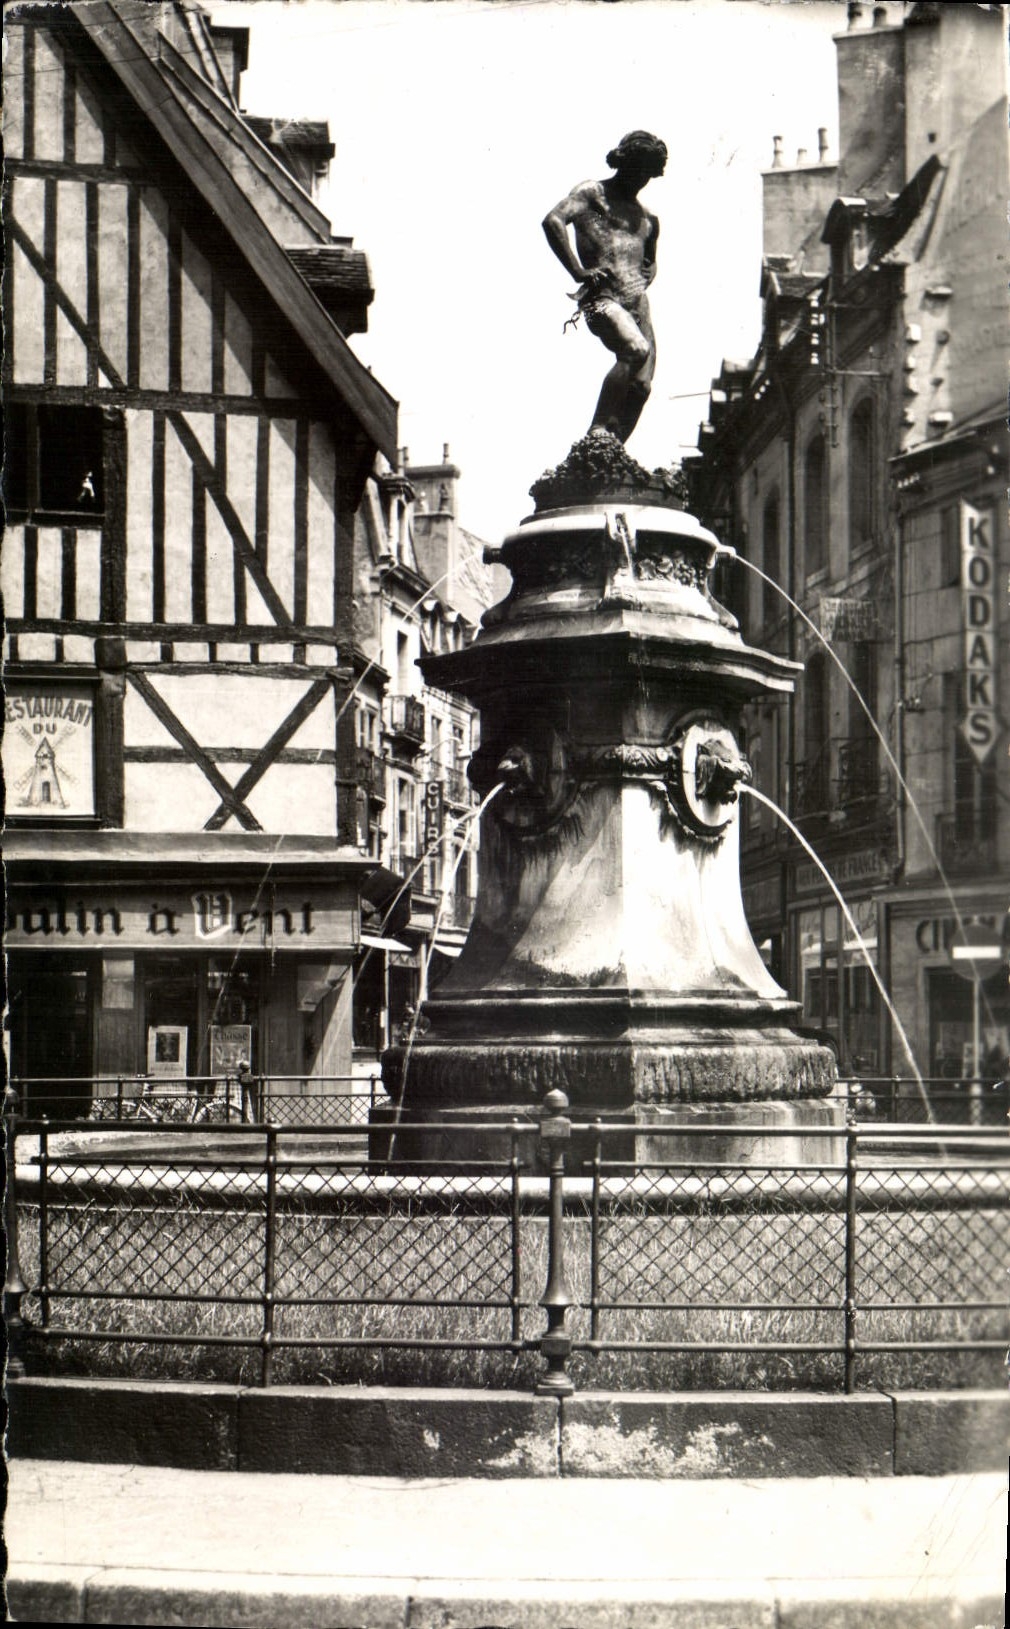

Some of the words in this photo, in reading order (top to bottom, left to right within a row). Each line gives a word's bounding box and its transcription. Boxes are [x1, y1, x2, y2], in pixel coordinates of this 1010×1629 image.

[968, 516, 992, 746] KODAKS
[5, 697, 92, 727] ESTAURANT
[33, 723, 57, 735] DU
[427, 782, 440, 854] CUIRS
